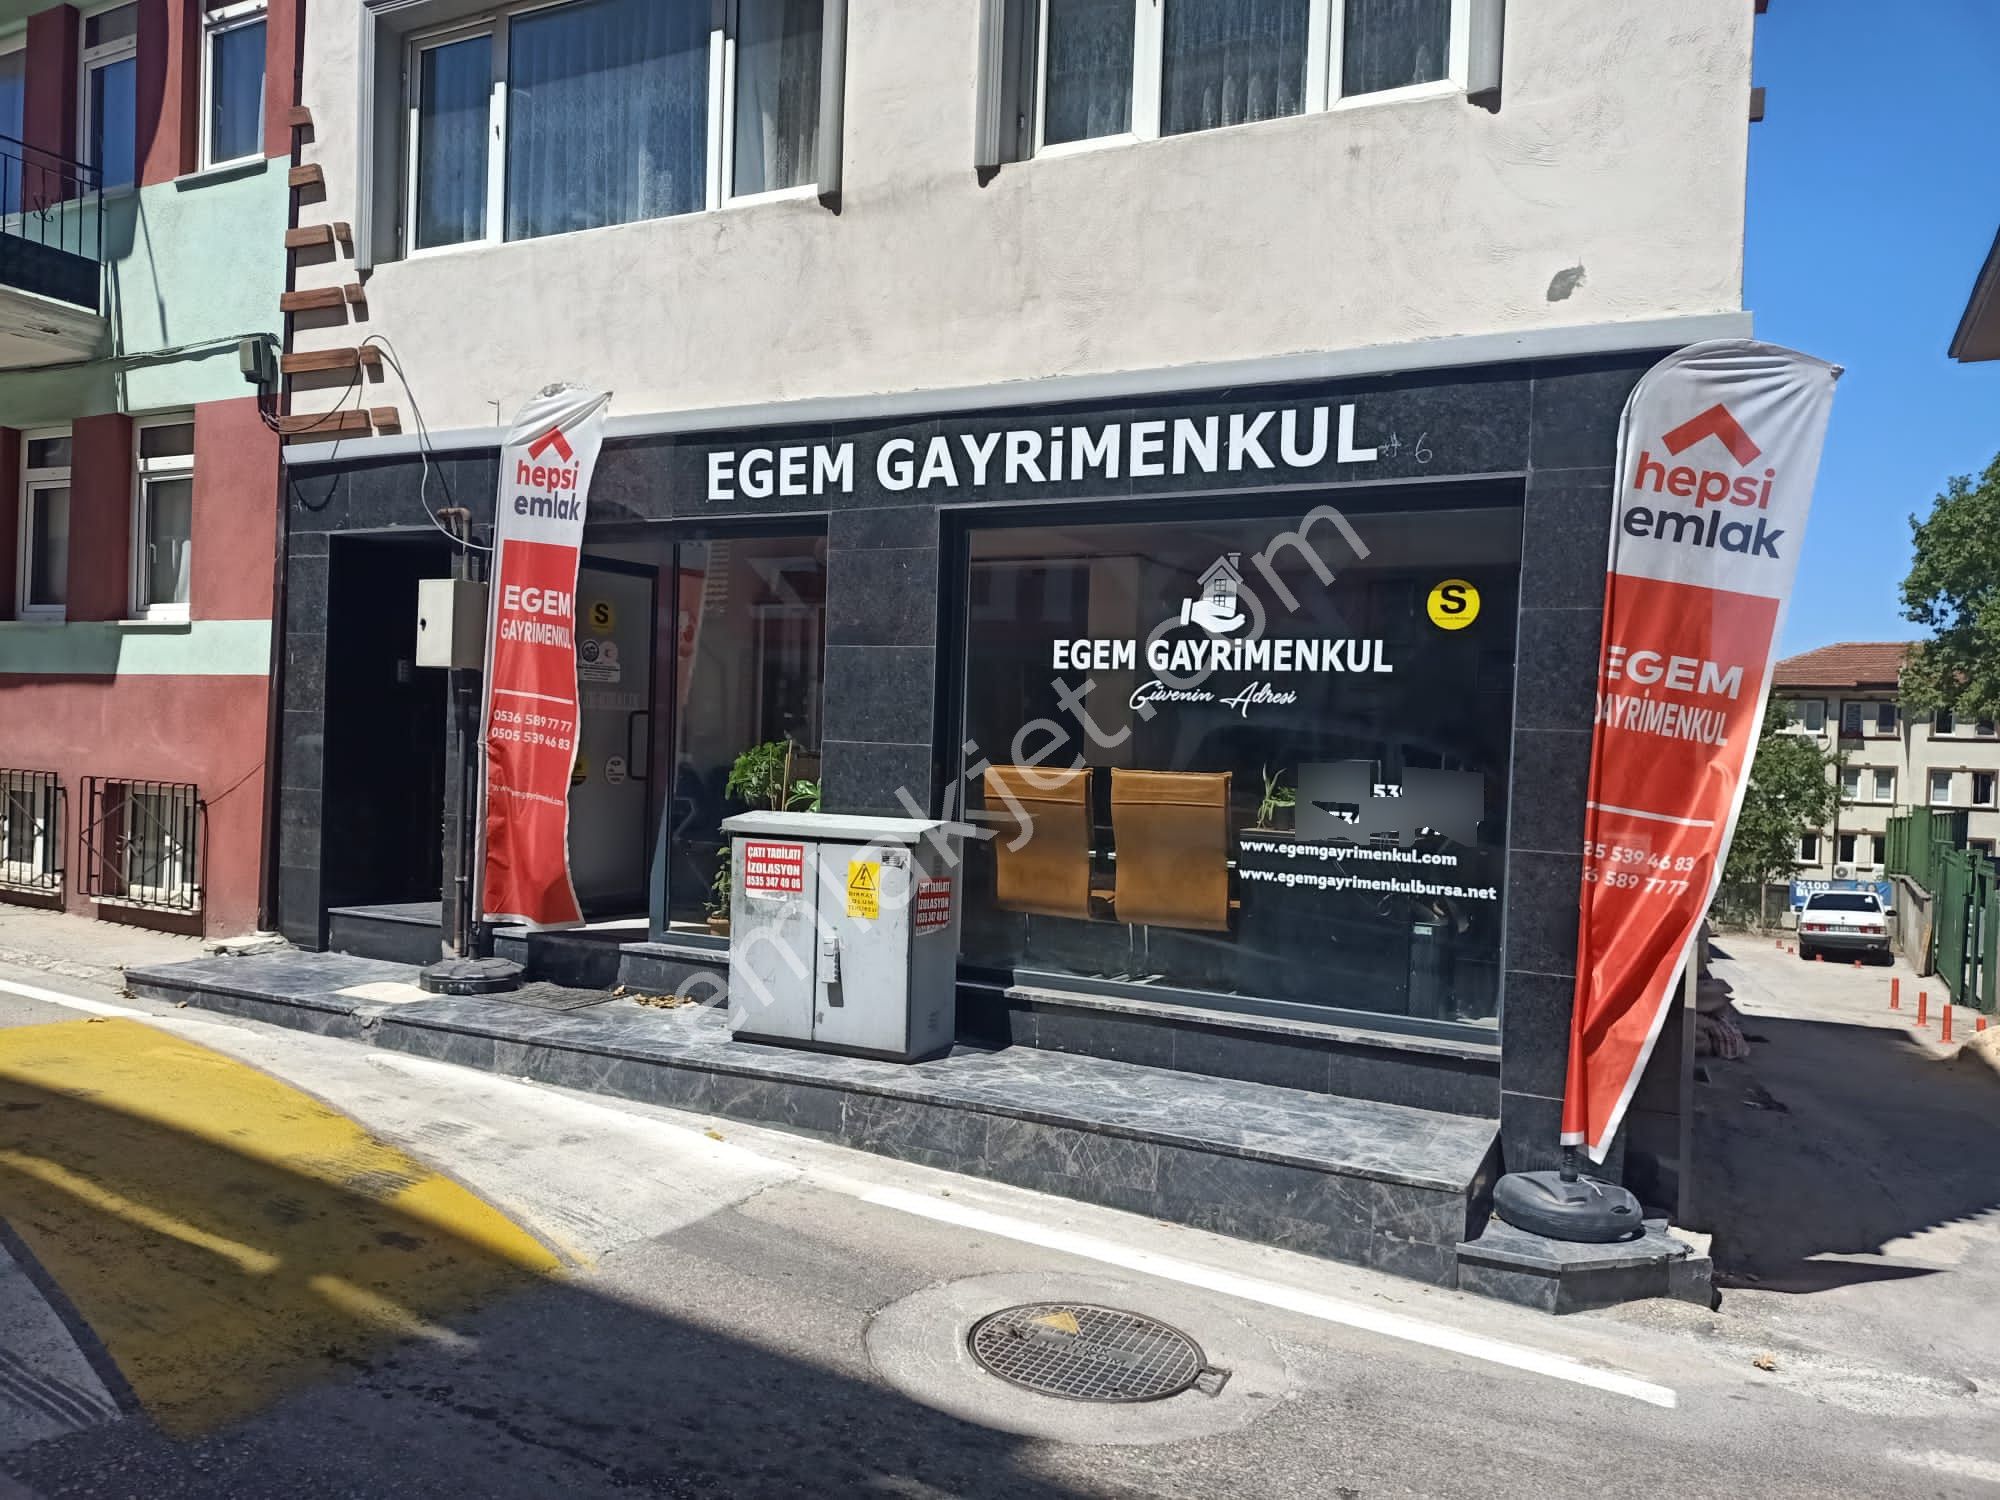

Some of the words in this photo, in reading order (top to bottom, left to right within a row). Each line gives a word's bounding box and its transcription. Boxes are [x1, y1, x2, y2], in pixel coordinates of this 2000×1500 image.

[516, 460, 580, 493] hepsi
[707, 443, 854, 500] EGEM
[1634, 451, 1775, 509] hepsi
[514, 491, 581, 520] emlak
[1624, 507, 1785, 559] emlak
[504, 585, 571, 619] EGEM
[1440, 584, 1467, 614] S
[501, 616, 572, 650] GAYRİMENKUL
[1053, 639, 1136, 670] EGEM
[1129, 680, 1215, 709] Güvenin
[1219, 681, 1297, 718] Adresi
[493, 709, 521, 724] 0536
[525, 714, 546, 727] 589
[491, 727, 520, 741] 0505
[524, 732, 544, 745] 539
[558, 739, 570, 750] 83
[748, 847, 765, 858] ÇATI
[1240, 840, 1457, 866] www.egemgayrimenkul.com
[1610, 846, 1644, 865] 539
[1647, 853, 1671, 870] 46
[1674, 857, 1694, 872] 83
[747, 860, 800, 876] İZOLASYON
[1604, 870, 1639, 889] 589
[1239, 868, 1497, 900] www.egemgayrimenkulbursa.net
